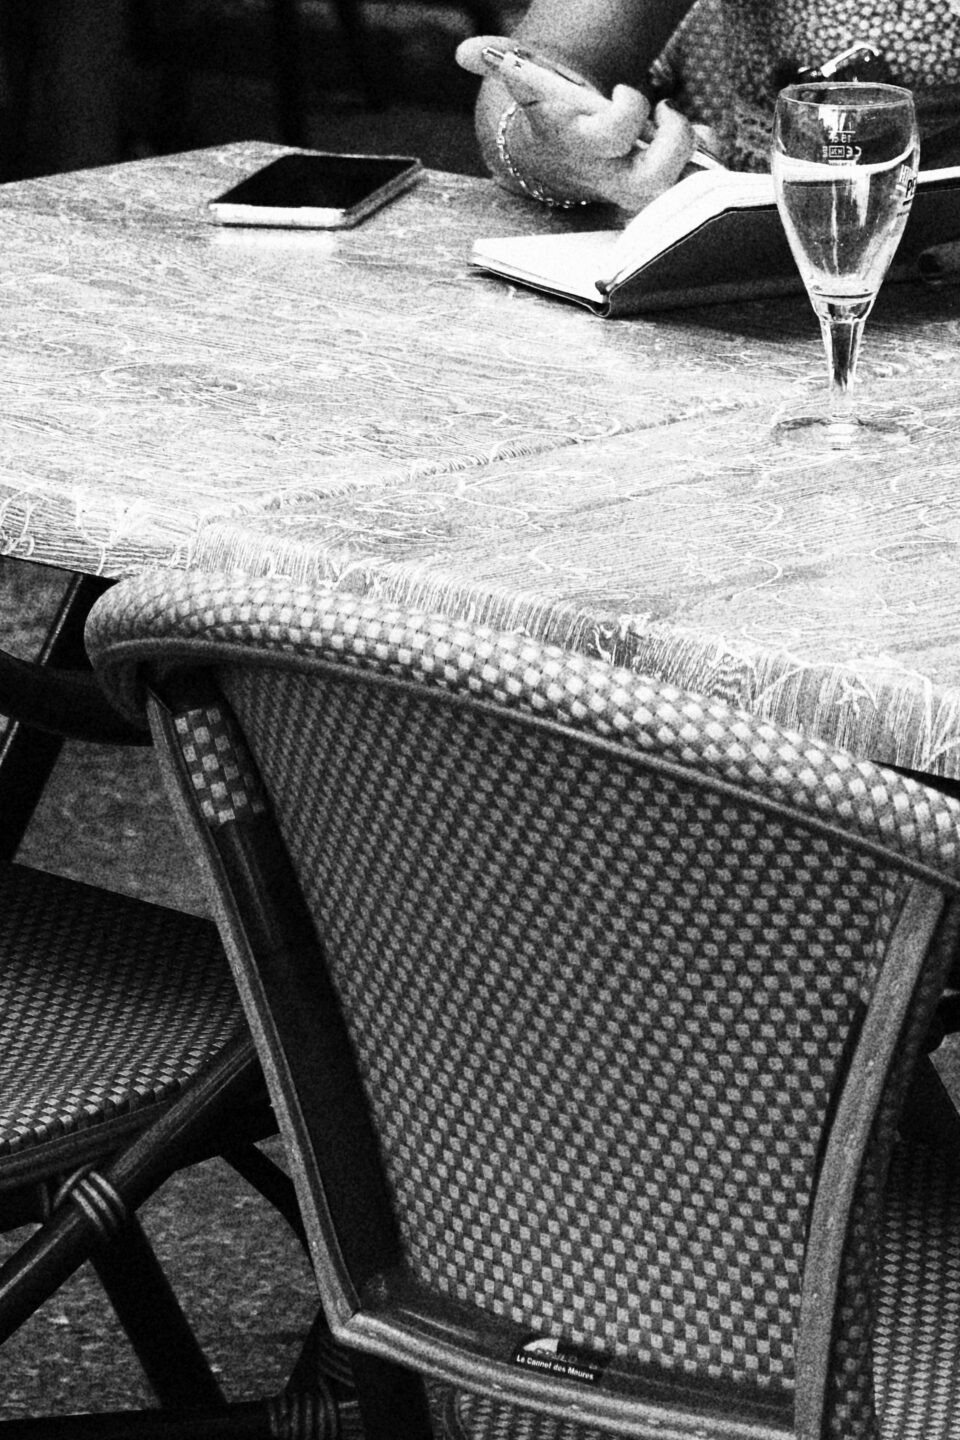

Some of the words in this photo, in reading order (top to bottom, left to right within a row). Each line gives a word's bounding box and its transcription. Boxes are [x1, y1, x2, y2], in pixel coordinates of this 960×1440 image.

[516, 1355, 525, 1363] Le
[526, 1357, 552, 1369] Cannet
[553, 1363, 566, 1373] des
[567, 1366, 594, 1380] Maures
